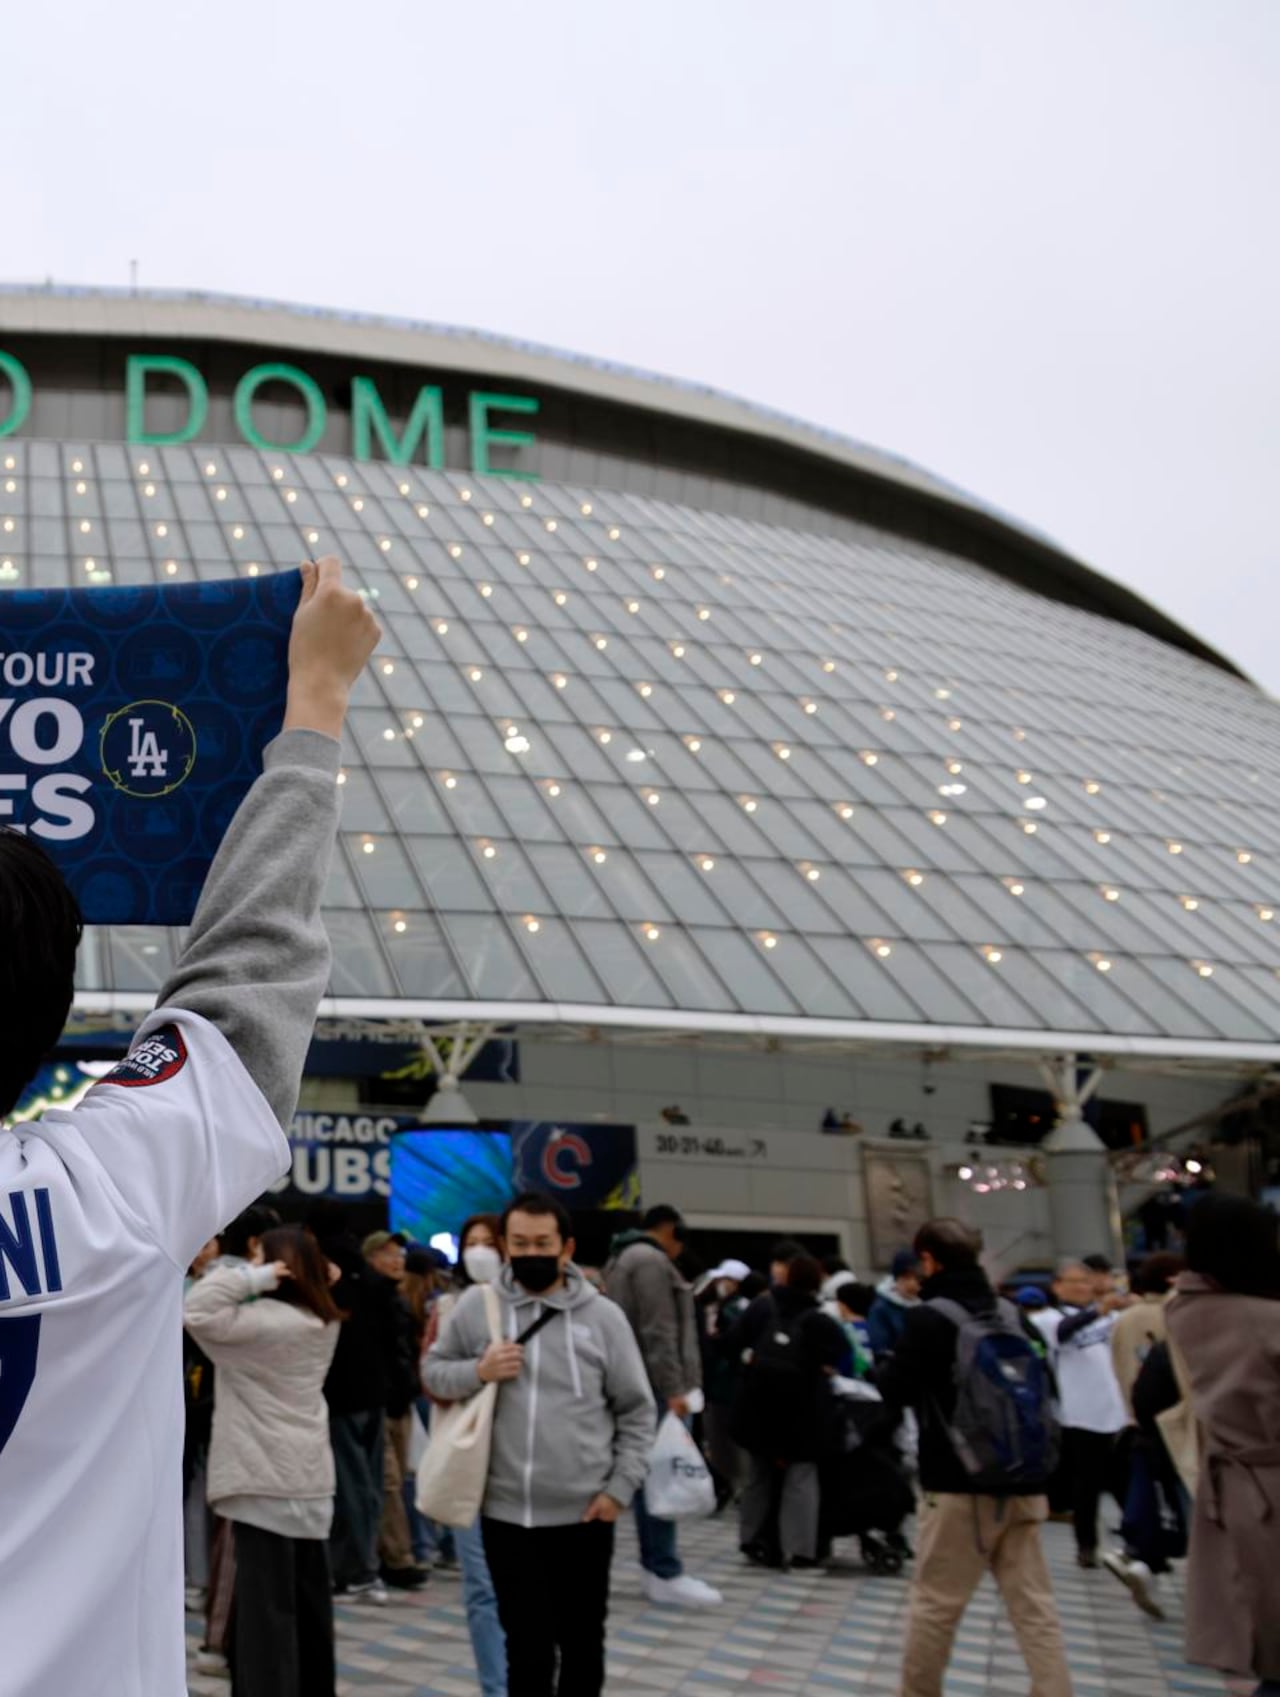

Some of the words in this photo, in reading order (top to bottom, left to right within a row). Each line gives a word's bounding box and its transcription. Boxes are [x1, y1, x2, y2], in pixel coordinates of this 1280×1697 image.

[125, 352, 542, 483] DOME
[127, 718, 168, 777] LA
[285, 1115, 398, 1144] HICAGO
